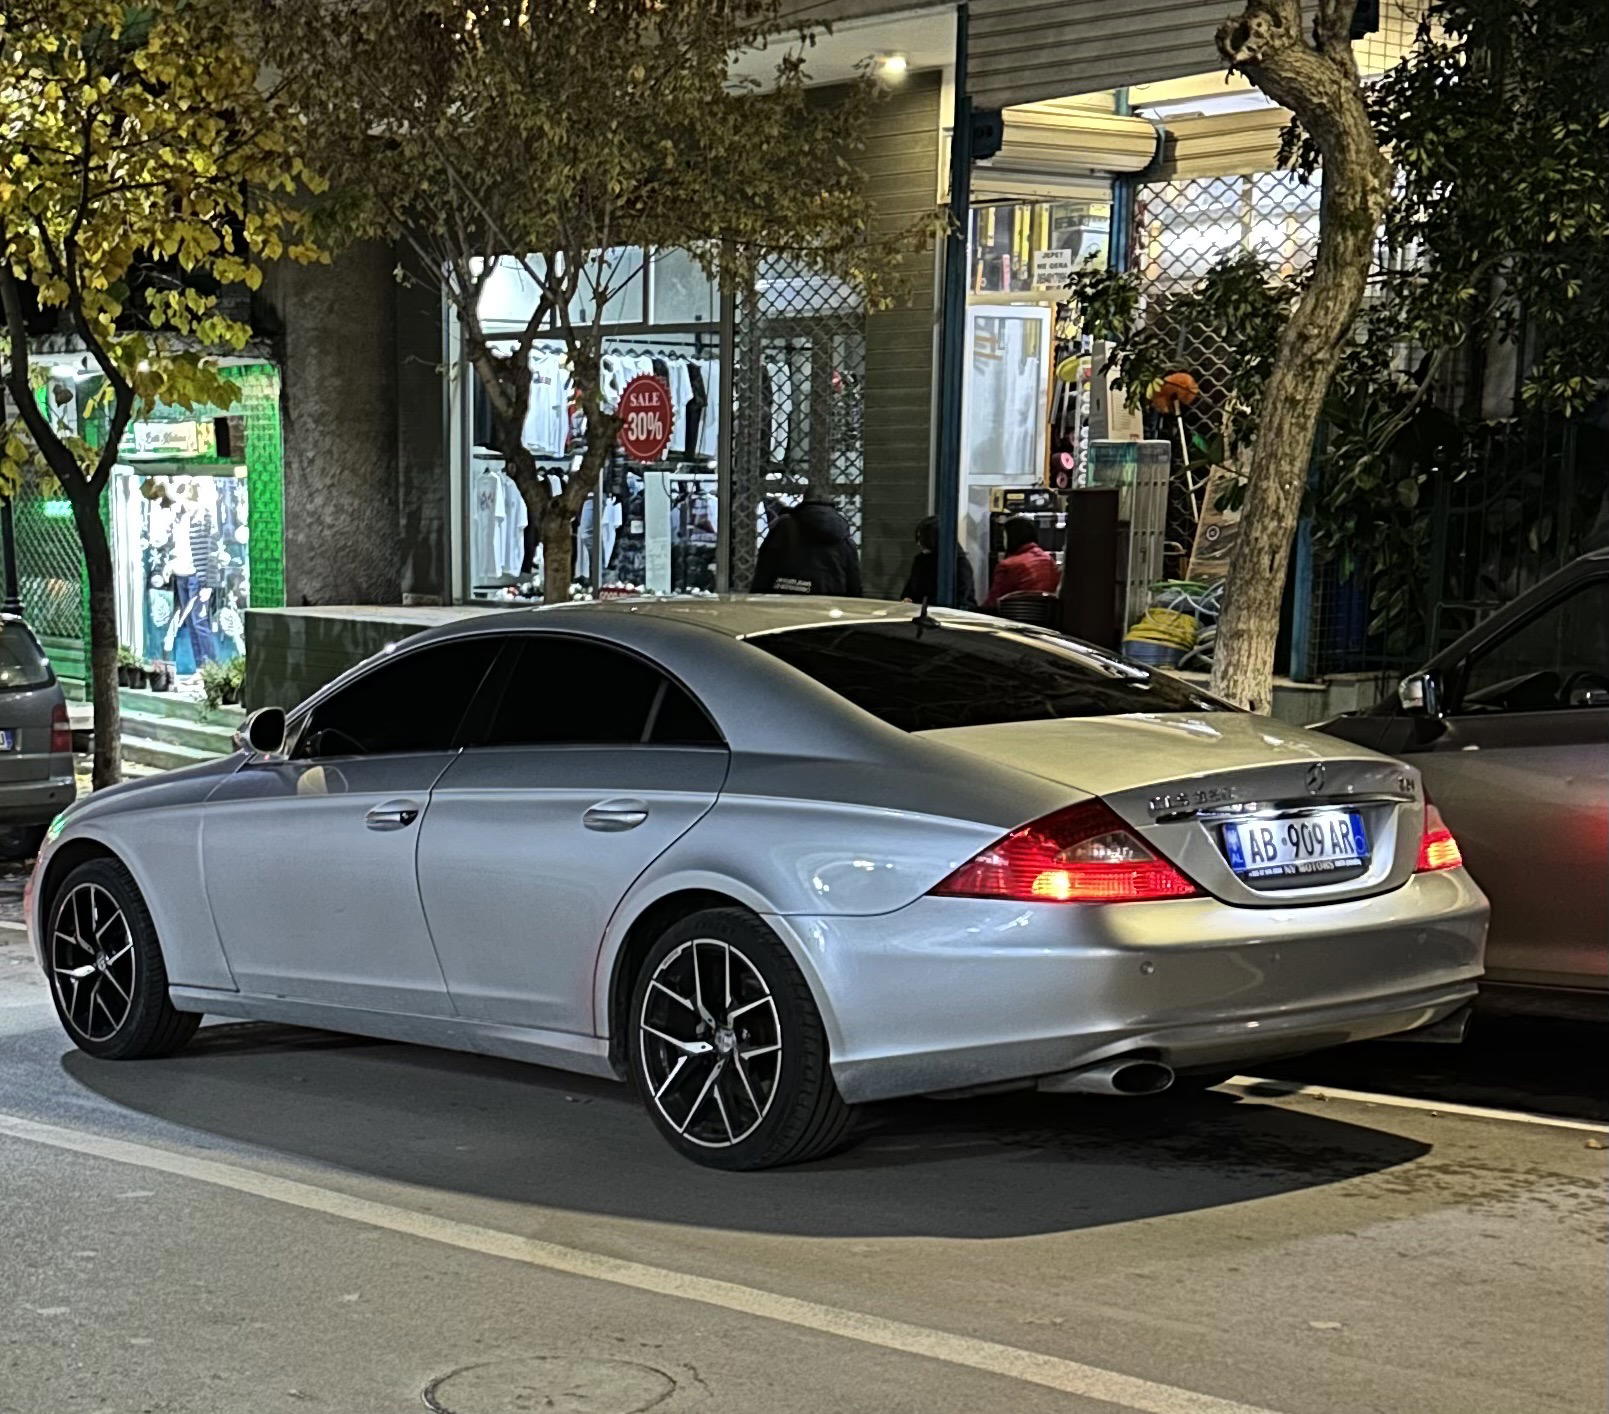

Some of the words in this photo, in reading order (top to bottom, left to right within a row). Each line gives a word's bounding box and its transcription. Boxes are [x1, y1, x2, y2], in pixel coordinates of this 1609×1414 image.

[629, 391, 661, 407] SALE
[623, 411, 663, 441] -30%
[1249, 827, 1278, 863] AB
[1287, 821, 1325, 858] 909
[1329, 819, 1355, 855] AR
[1298, 859, 1335, 874] MOTORS
